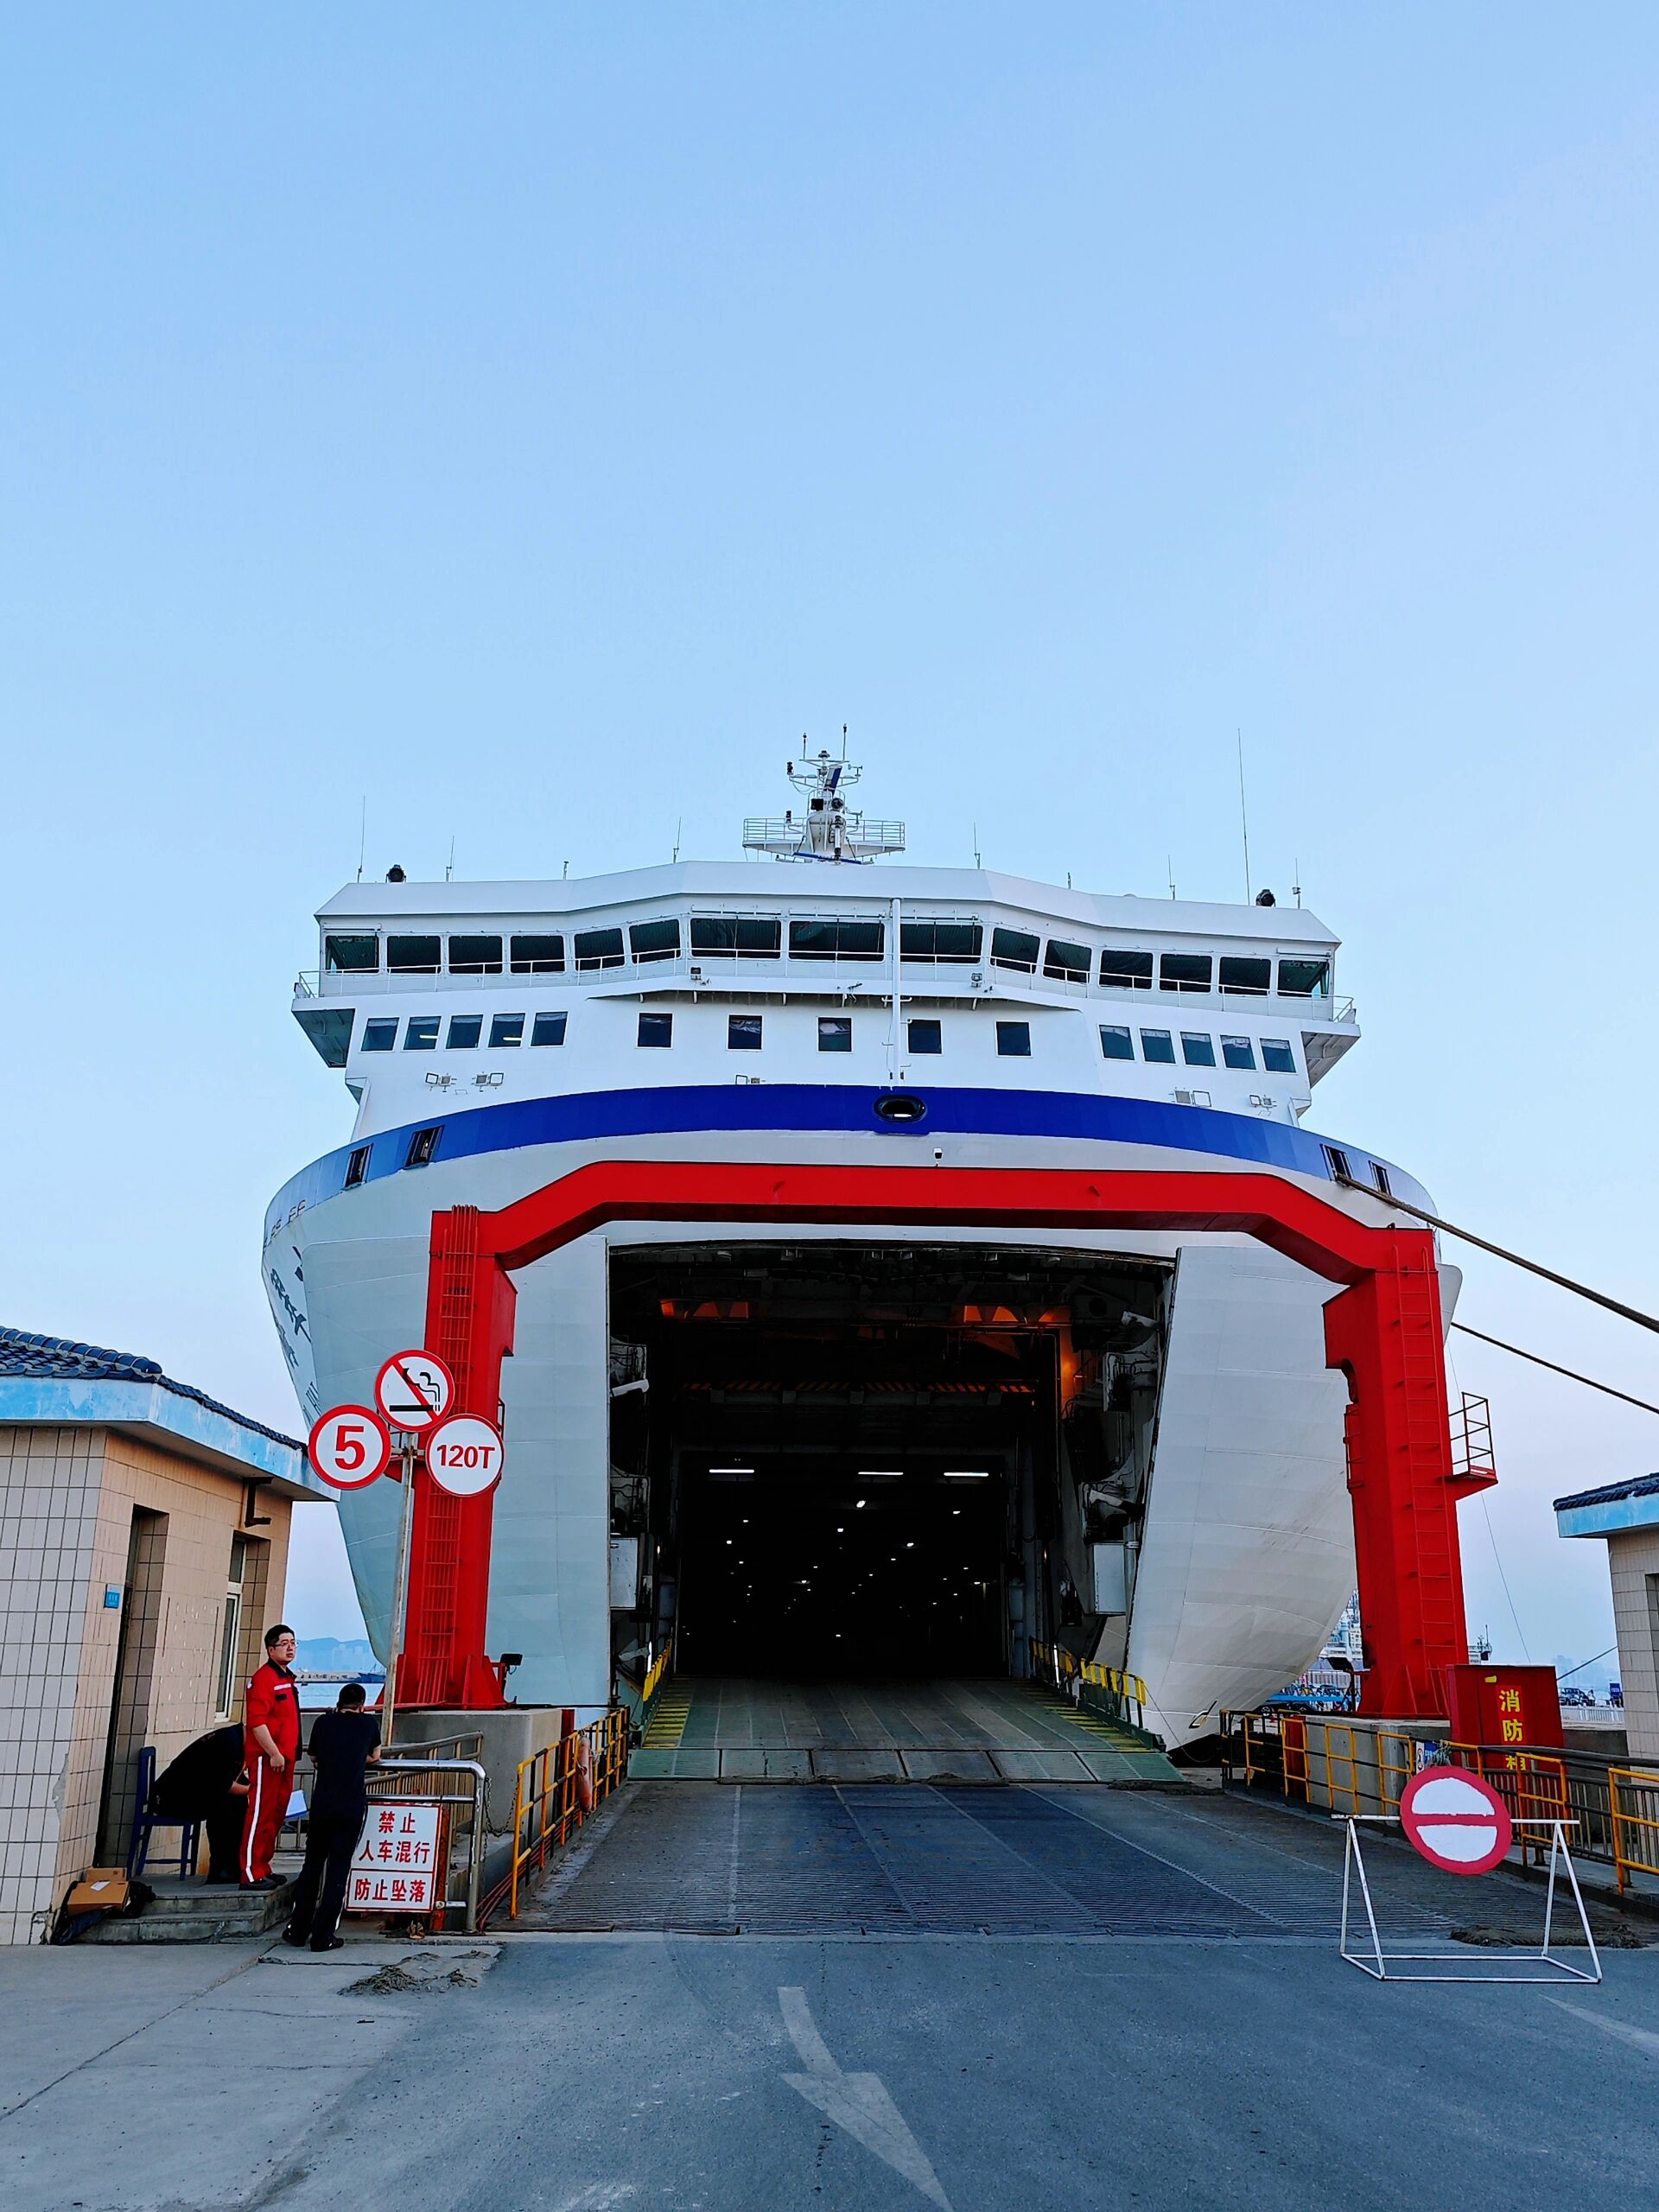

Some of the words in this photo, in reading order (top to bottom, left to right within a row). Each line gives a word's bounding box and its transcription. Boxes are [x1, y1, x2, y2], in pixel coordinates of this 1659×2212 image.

[334, 1425, 366, 1471] 5
[436, 1444, 496, 1470] 120T
[378, 1810, 416, 1834] 禁止
[359, 1840, 430, 1864] 人车混行
[354, 1878, 426, 1903] 防止坠落
